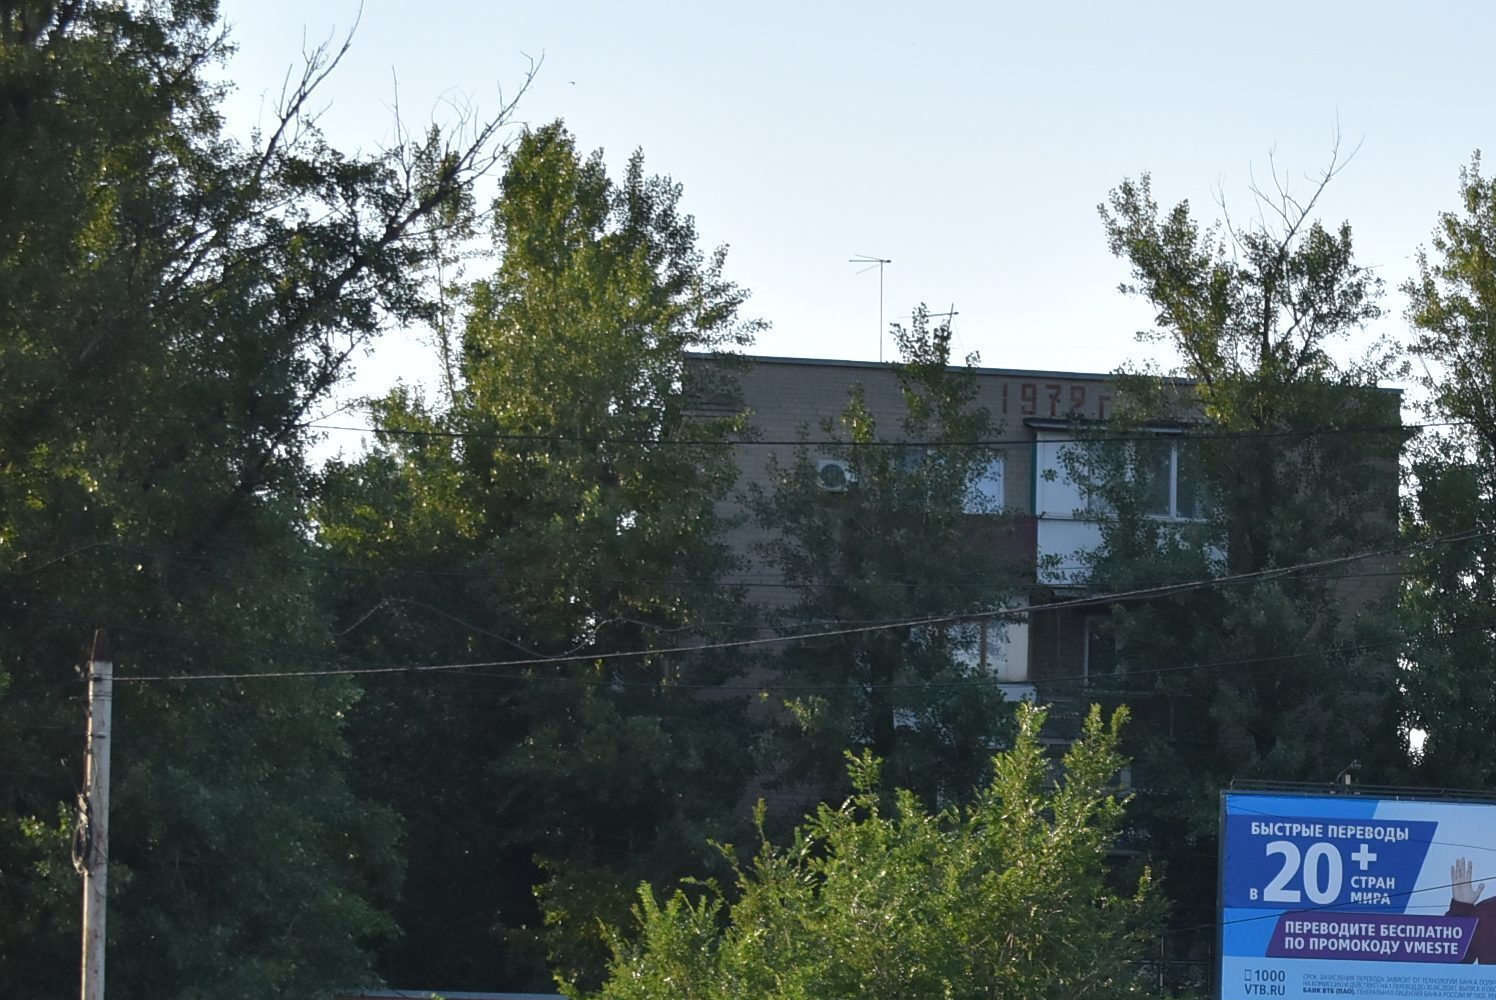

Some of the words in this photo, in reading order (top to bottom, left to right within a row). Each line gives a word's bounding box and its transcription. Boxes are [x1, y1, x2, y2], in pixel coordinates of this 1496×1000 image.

[1251, 822, 1323, 838] БЫСТРЫЕ
[1328, 825, 1409, 842] ПЕРЕВОДЫ
[1351, 875, 1395, 890] СТРАН
[1351, 891, 1391, 905] МИРА
[1285, 920, 1376, 938] ПЕРЕВОДИТЕ
[1380, 924, 1463, 939] БЕСПЛАТНО
[1284, 937, 1305, 950] ПО
[1310, 938, 1400, 955] ПРОМОКОДУ
[1405, 941, 1459, 955] VMESTE
[1255, 970, 1285, 982] 1000
[1245, 984, 1285, 996] VTB.RU
